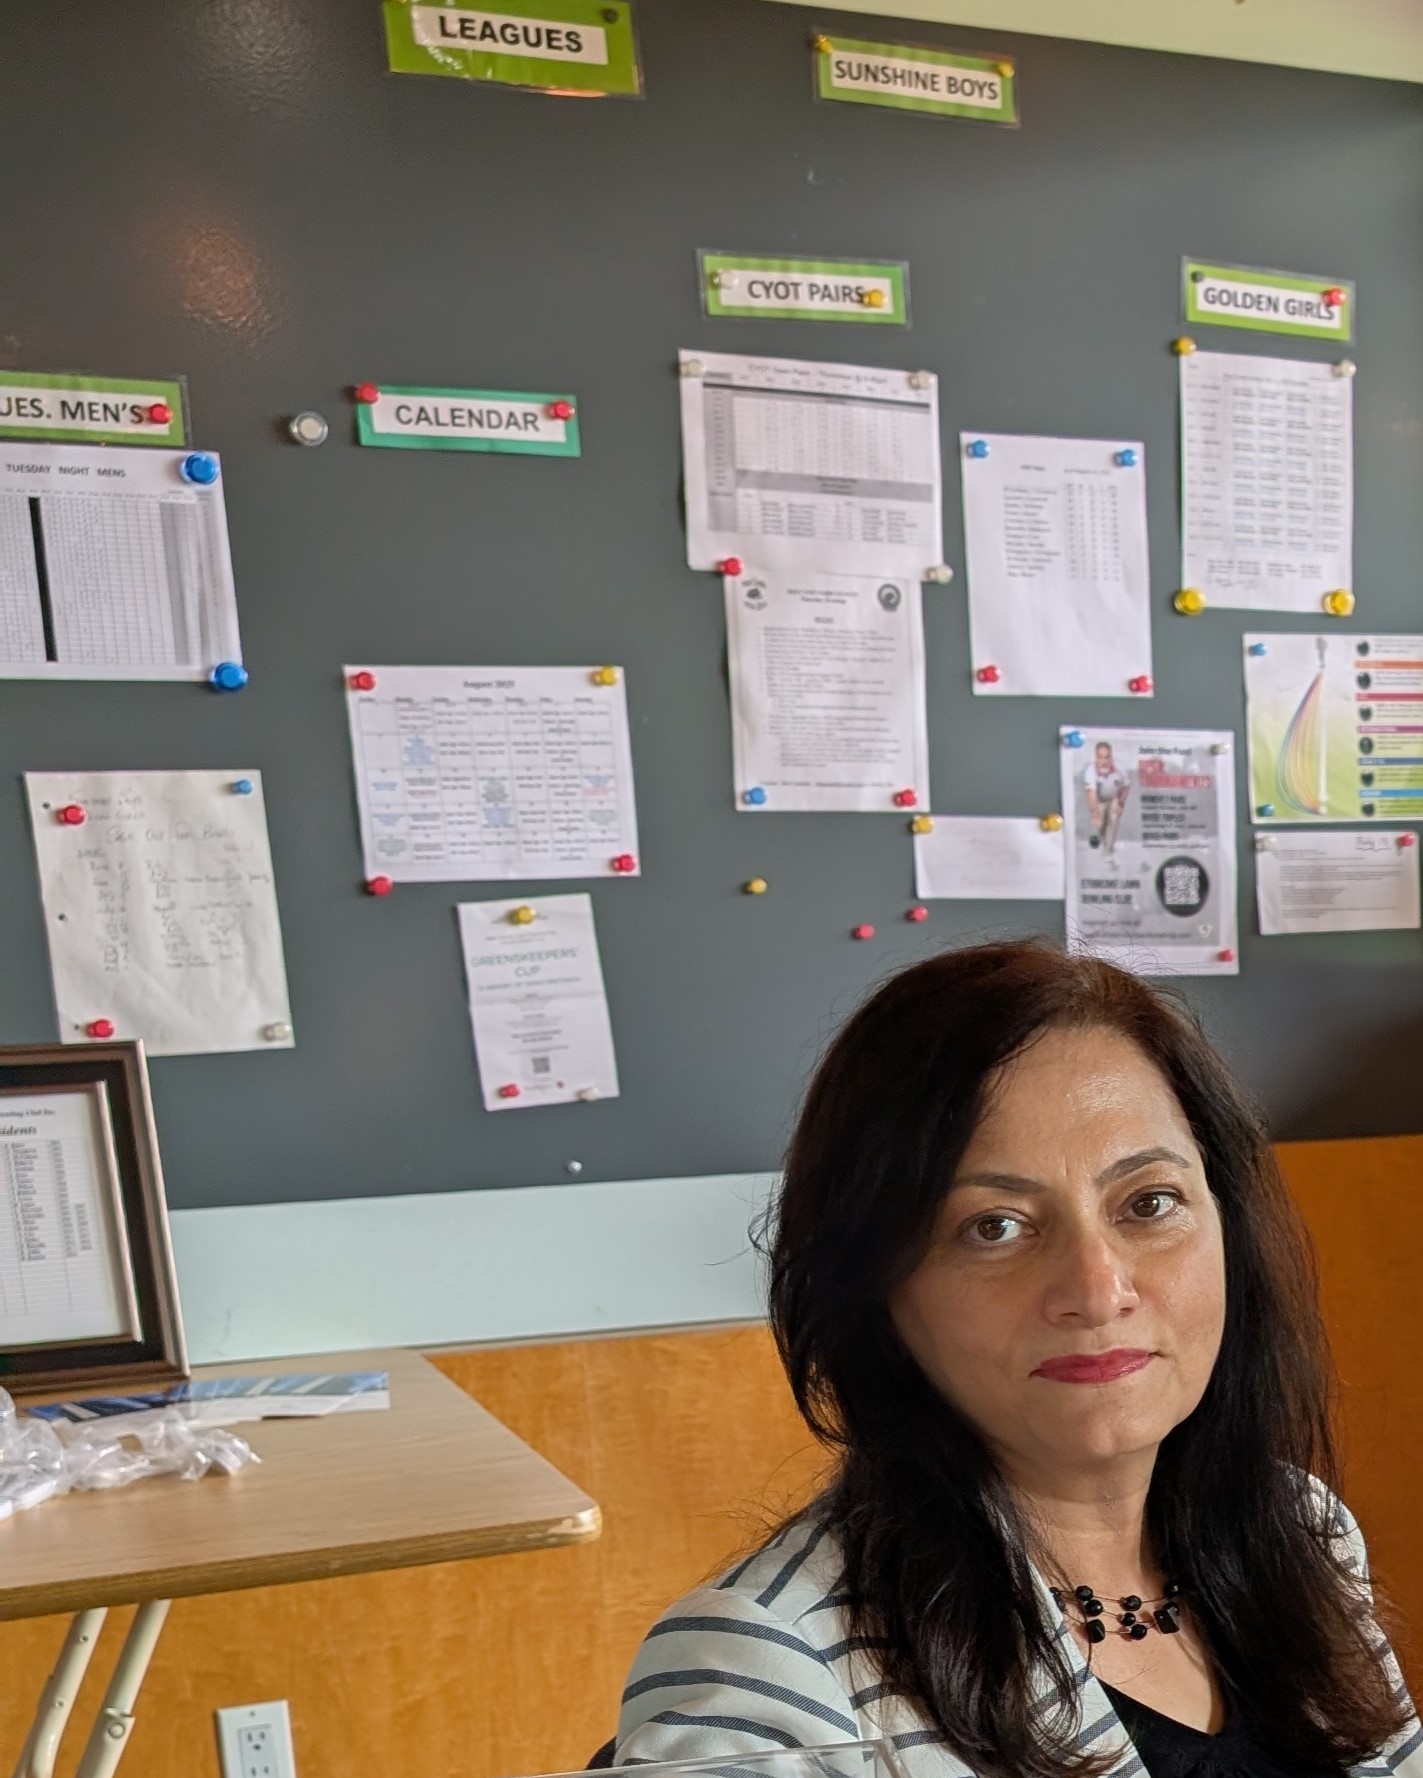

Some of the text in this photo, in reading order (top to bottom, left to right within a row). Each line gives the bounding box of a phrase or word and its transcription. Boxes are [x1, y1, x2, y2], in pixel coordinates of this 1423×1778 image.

[438, 15, 584, 53] LEAGUES
[834, 60, 999, 100] SUNSHINE BOYS
[747, 280, 865, 304] CYOT PAIRS
[1203, 287, 1335, 320] GOLDEN GIRLS
[60, 400, 145, 424] MEN'S
[395, 404, 541, 432] CALENDAR
[5, 463, 126, 478] TUESDAY NIGHT MENS
